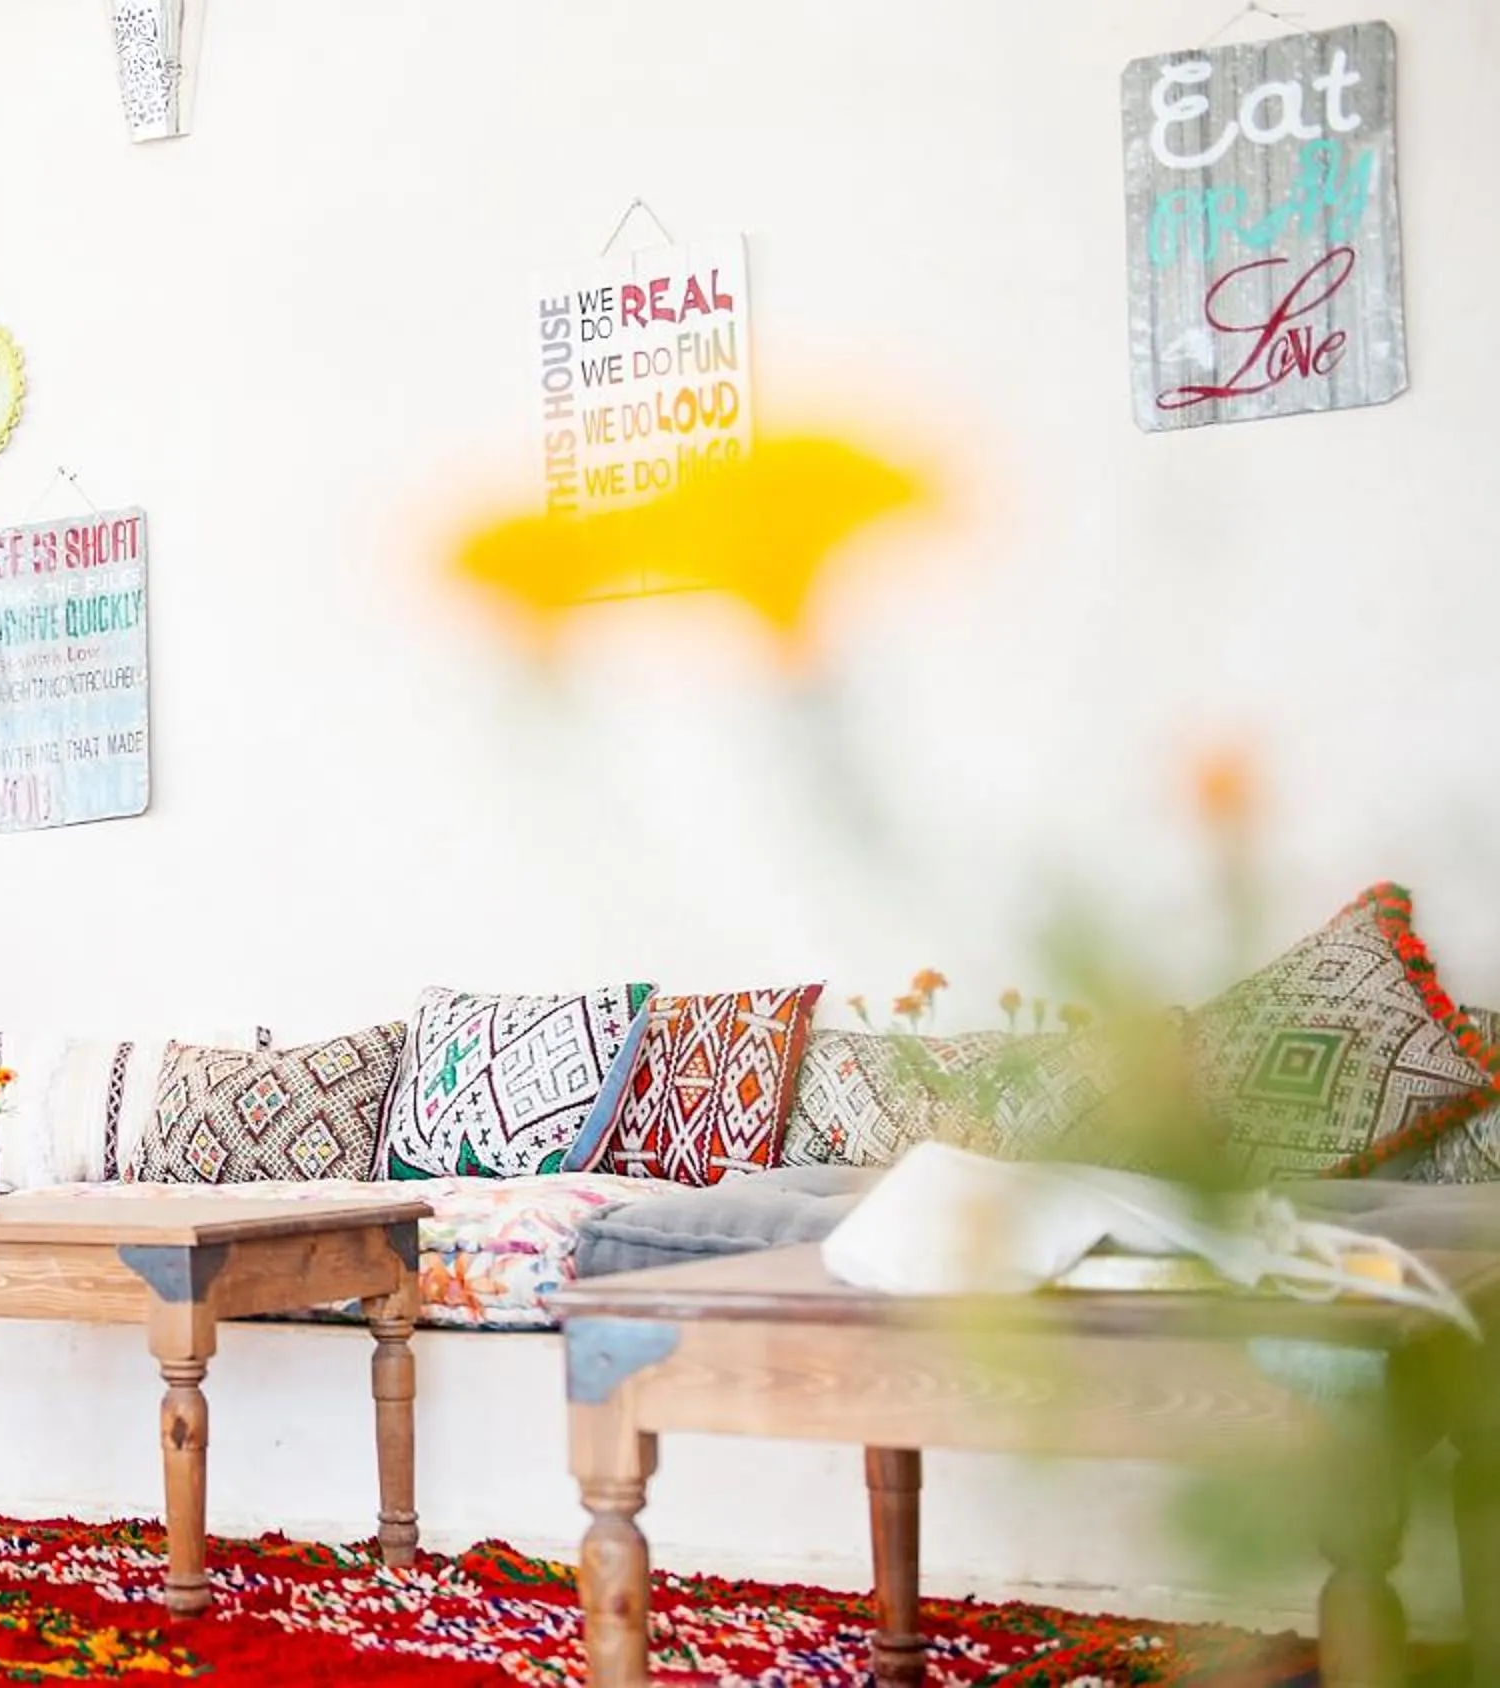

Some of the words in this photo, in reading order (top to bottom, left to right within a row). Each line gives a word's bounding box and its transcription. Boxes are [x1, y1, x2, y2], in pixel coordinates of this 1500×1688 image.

[1149, 49, 1361, 168] Eat
[578, 287, 614, 315] WE
[621, 269, 734, 328] REAL
[540, 295, 574, 420] HOUSE
[581, 316, 613, 342] DO
[581, 354, 623, 388] WE
[633, 347, 672, 378] DO
[677, 321, 738, 376] FUN
[583, 406, 616, 445] WE
[622, 401, 651, 442] DO
[656, 381, 740, 434] LOUD
[584, 463, 626, 497] WE
[633, 457, 671, 490] DO
[33, 531, 57, 574] IS
[65, 517, 141, 569] SHORT
[65, 589, 143, 639] QUICKLY
[67, 736, 100, 763] THAT
[106, 730, 144, 756] MADE
